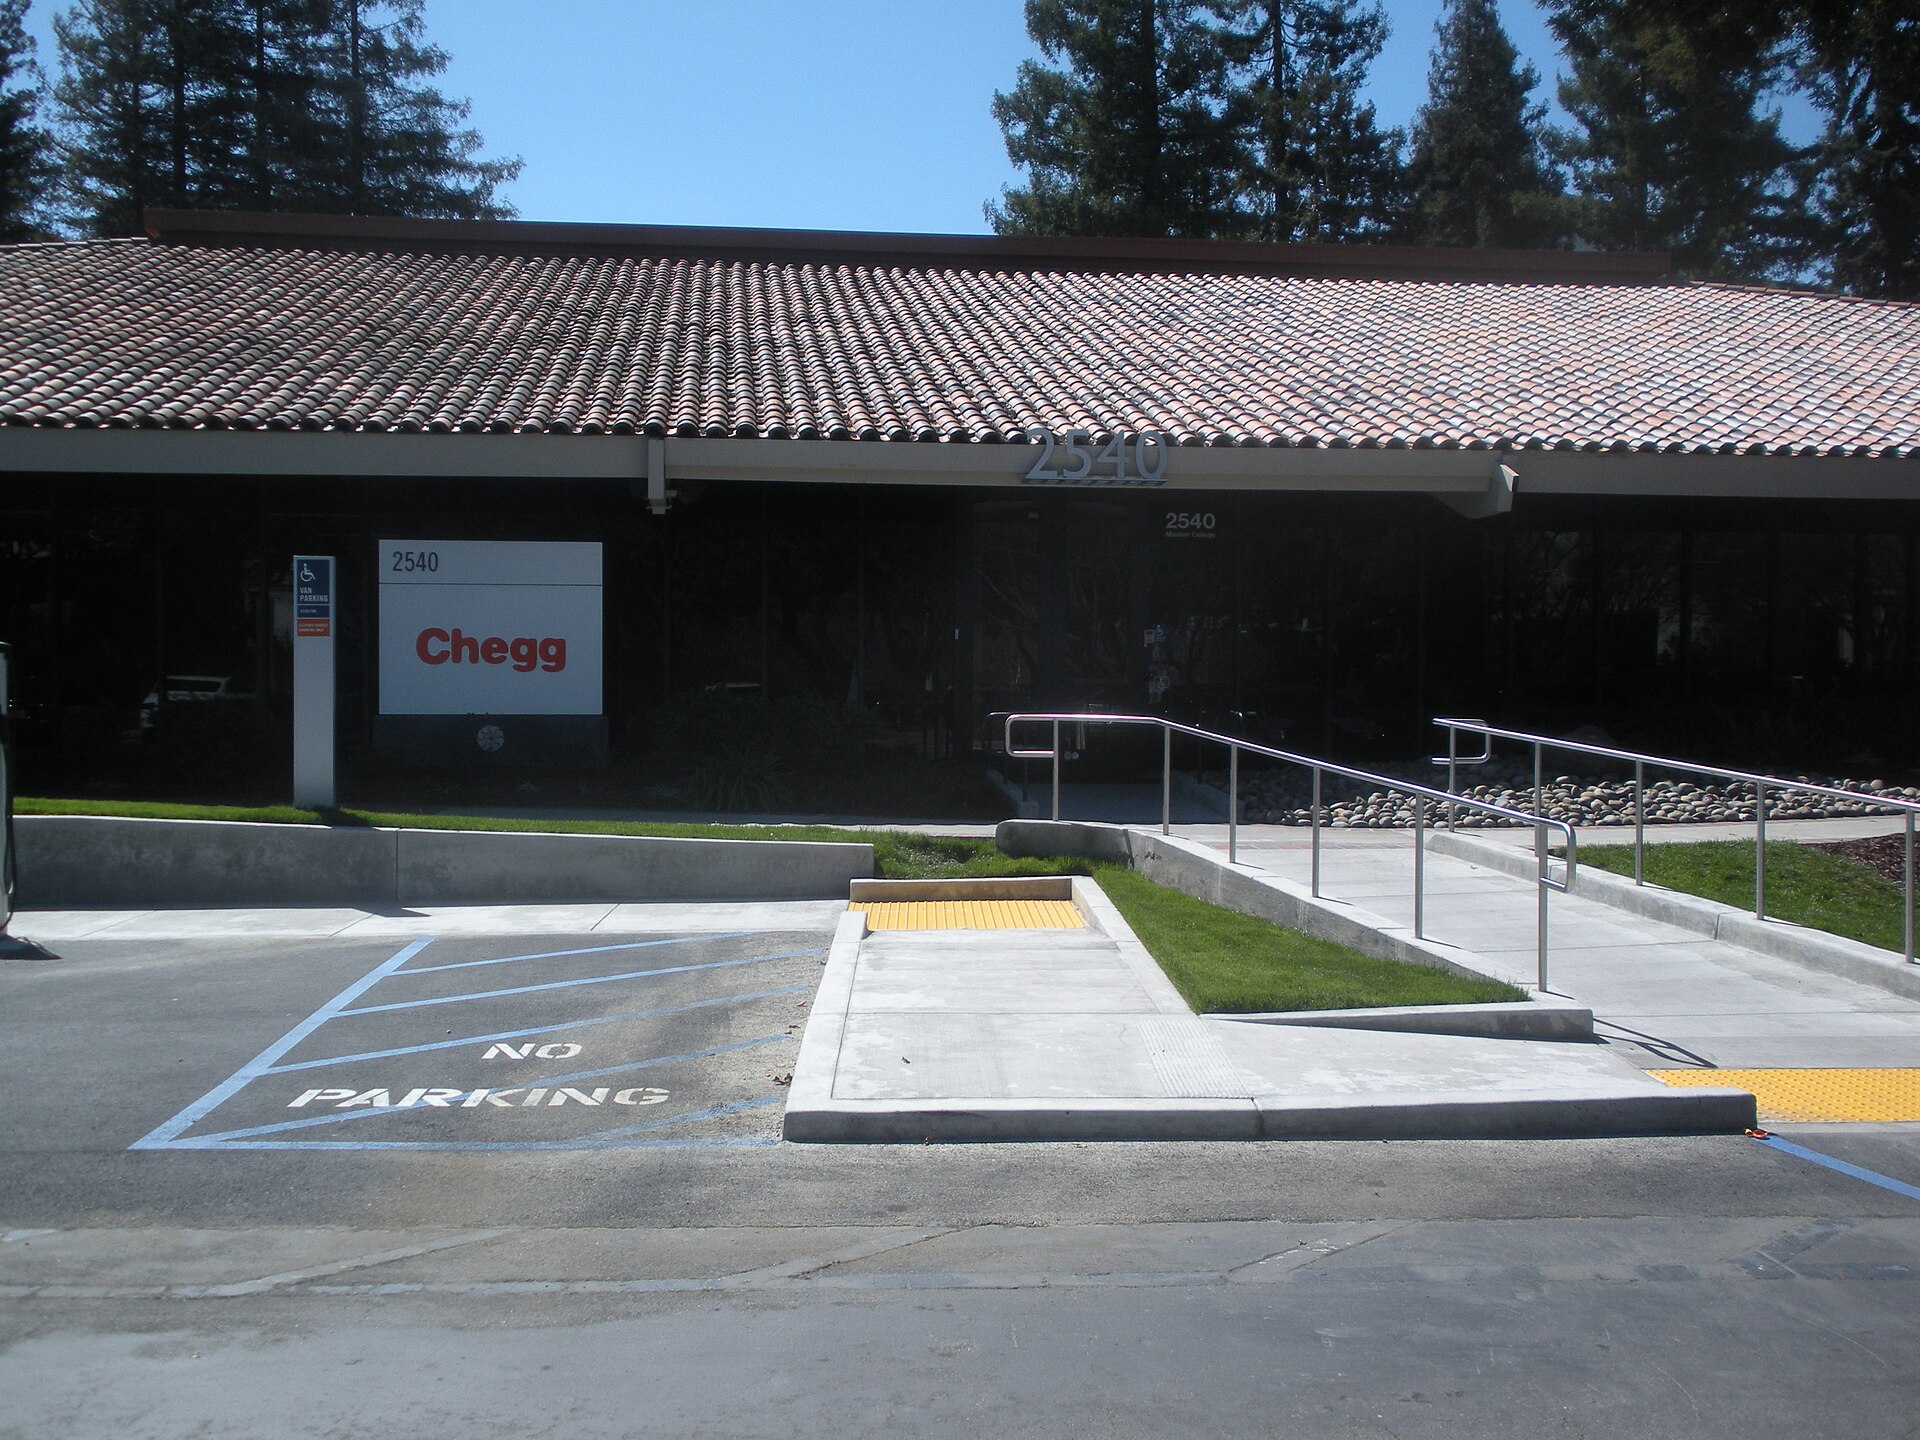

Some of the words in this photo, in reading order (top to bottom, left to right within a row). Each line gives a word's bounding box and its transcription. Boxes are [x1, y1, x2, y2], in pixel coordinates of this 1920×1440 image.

[1025, 427, 1168, 480] 2540
[1166, 512, 1216, 529] 2540
[392, 551, 439, 572] 2540
[299, 594, 329, 602] PARKING
[416, 627, 566, 672] Chegg
[481, 1043, 583, 1060] NO
[286, 1087, 671, 1108] PARKING
